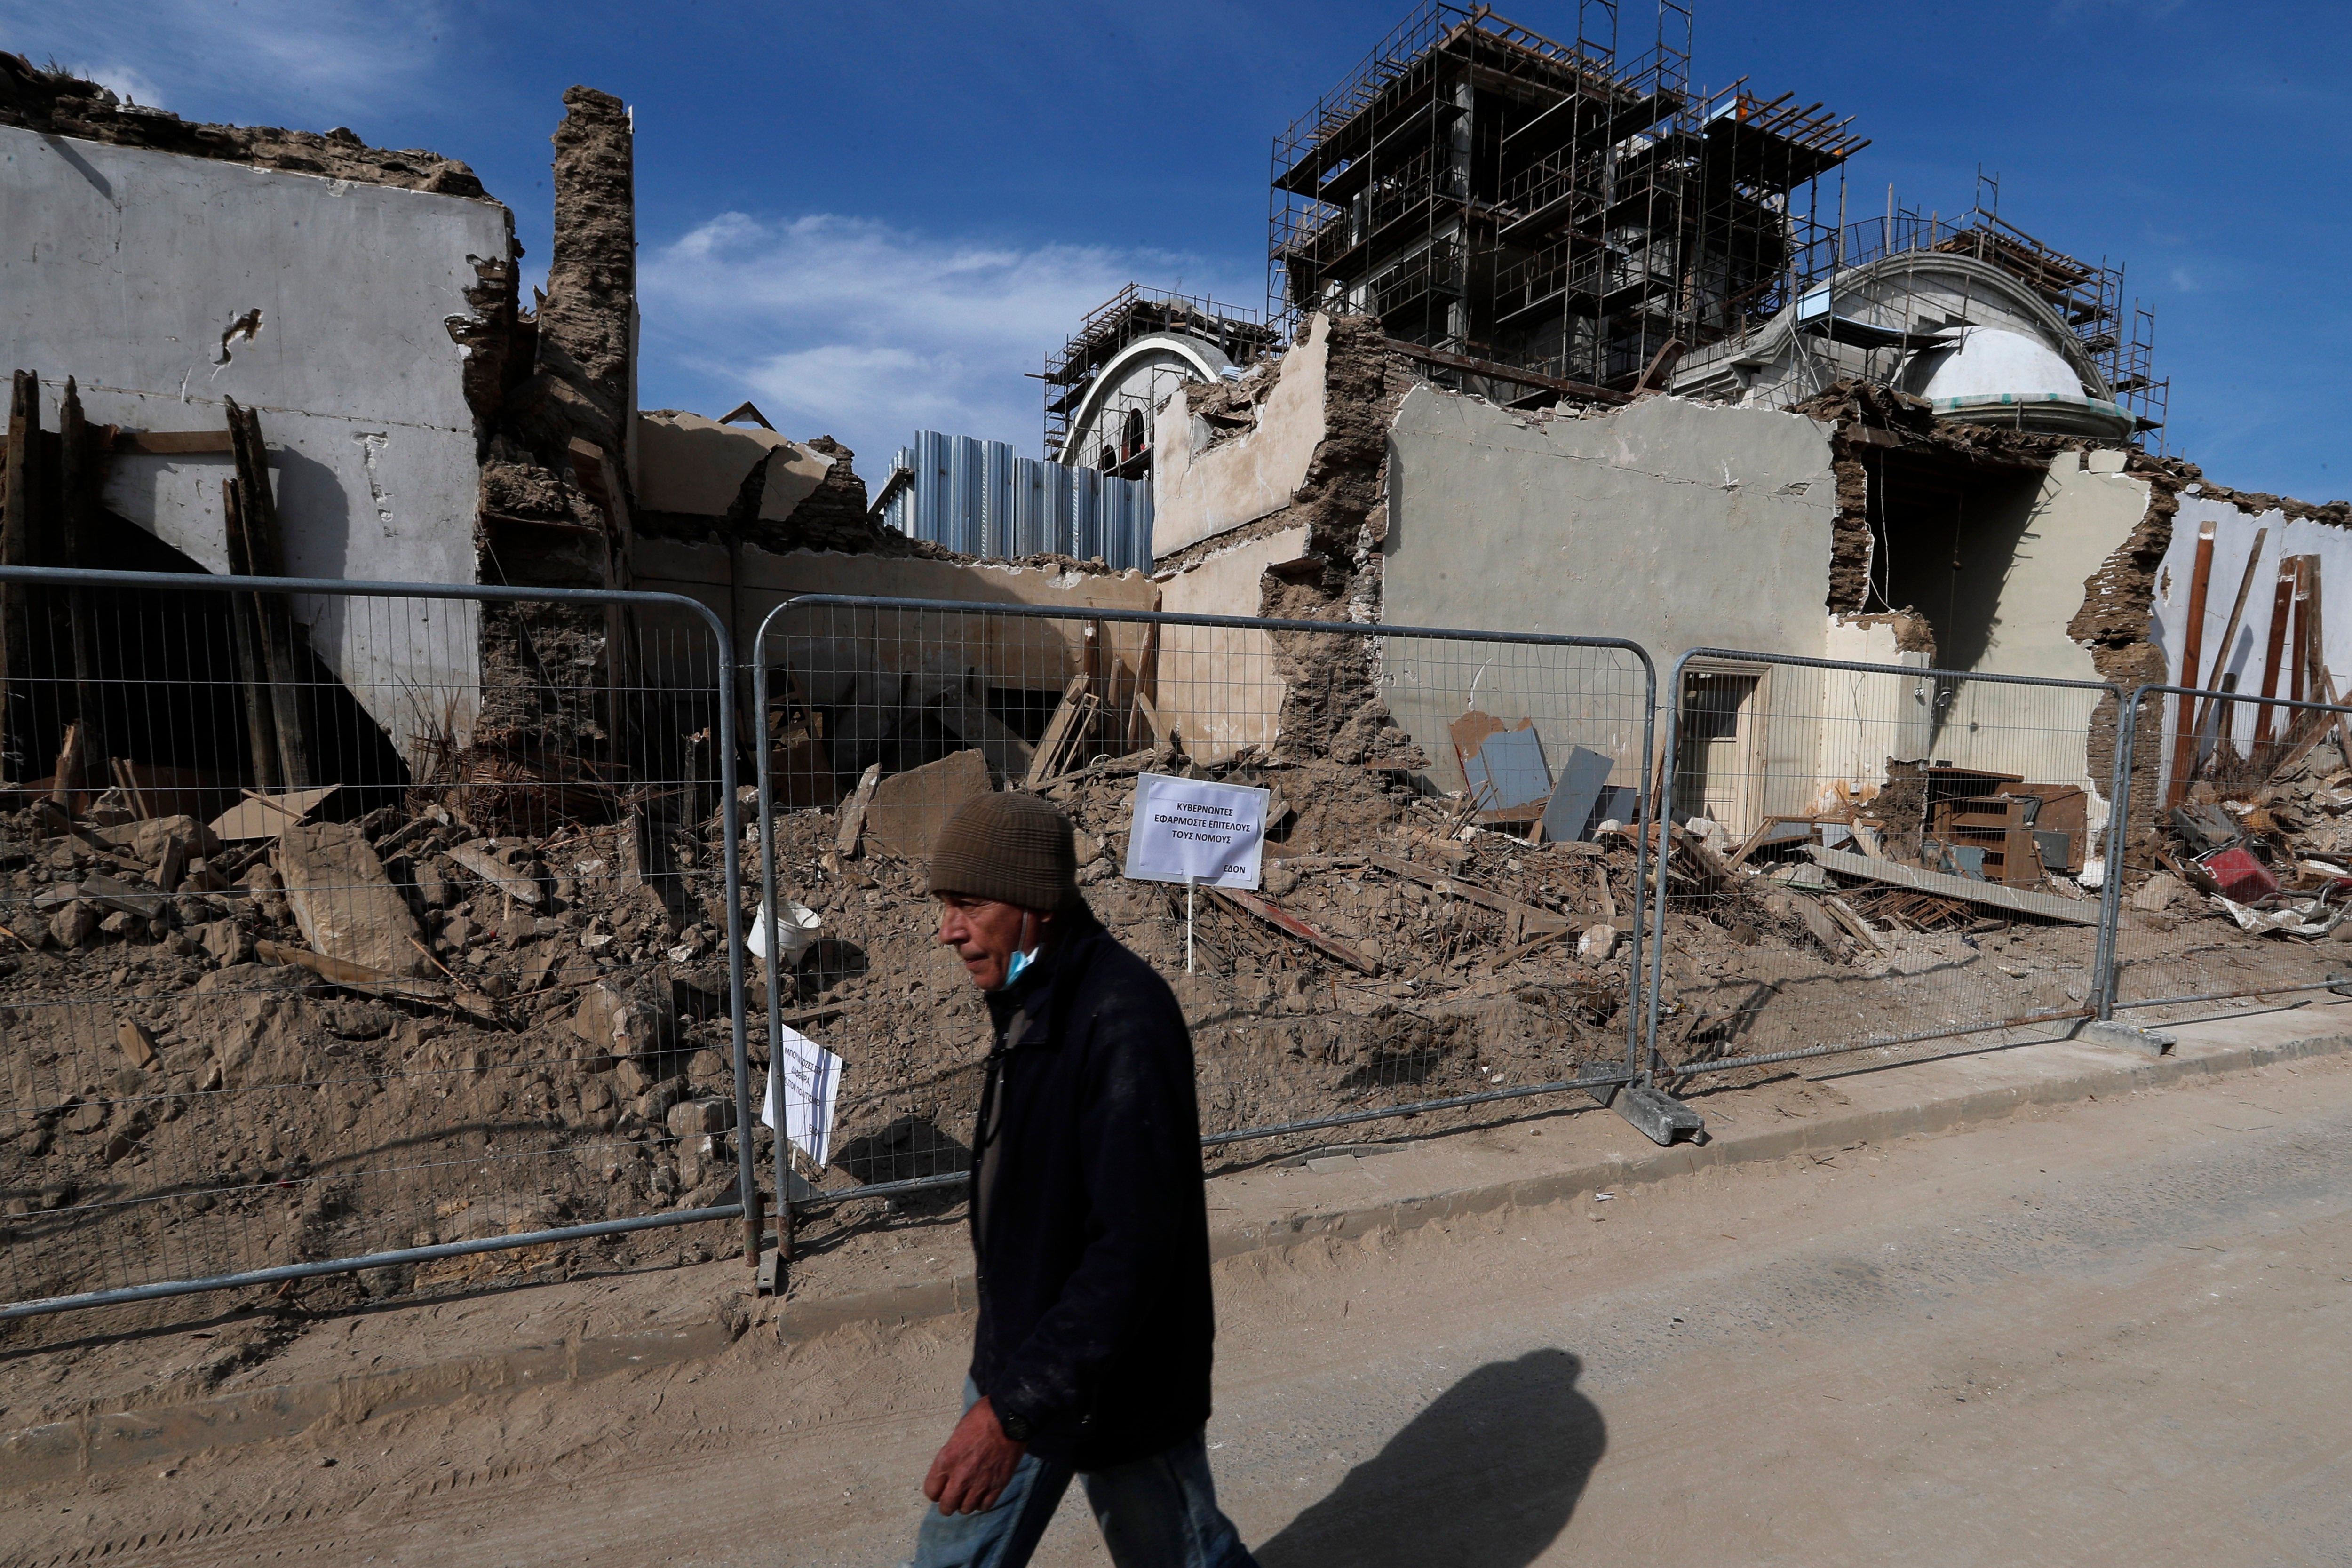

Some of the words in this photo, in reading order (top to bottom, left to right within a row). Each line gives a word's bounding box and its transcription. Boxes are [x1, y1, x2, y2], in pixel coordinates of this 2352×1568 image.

[1177, 803, 1233, 816] ΚΥΒΕΡΝΩΝΤΕΣ
[1154, 814, 1207, 828] ΕΦΑΡΜΟΣΤΕ
[1208, 821, 1250, 832] ΕΠΙΤΕΛΟΥΣ
[1172, 830, 1193, 840] ΤΟΥΣ
[1195, 834, 1231, 844] ΝΟΜΟΥΣ
[1224, 865, 1246, 874] ΕΔΟΝ
